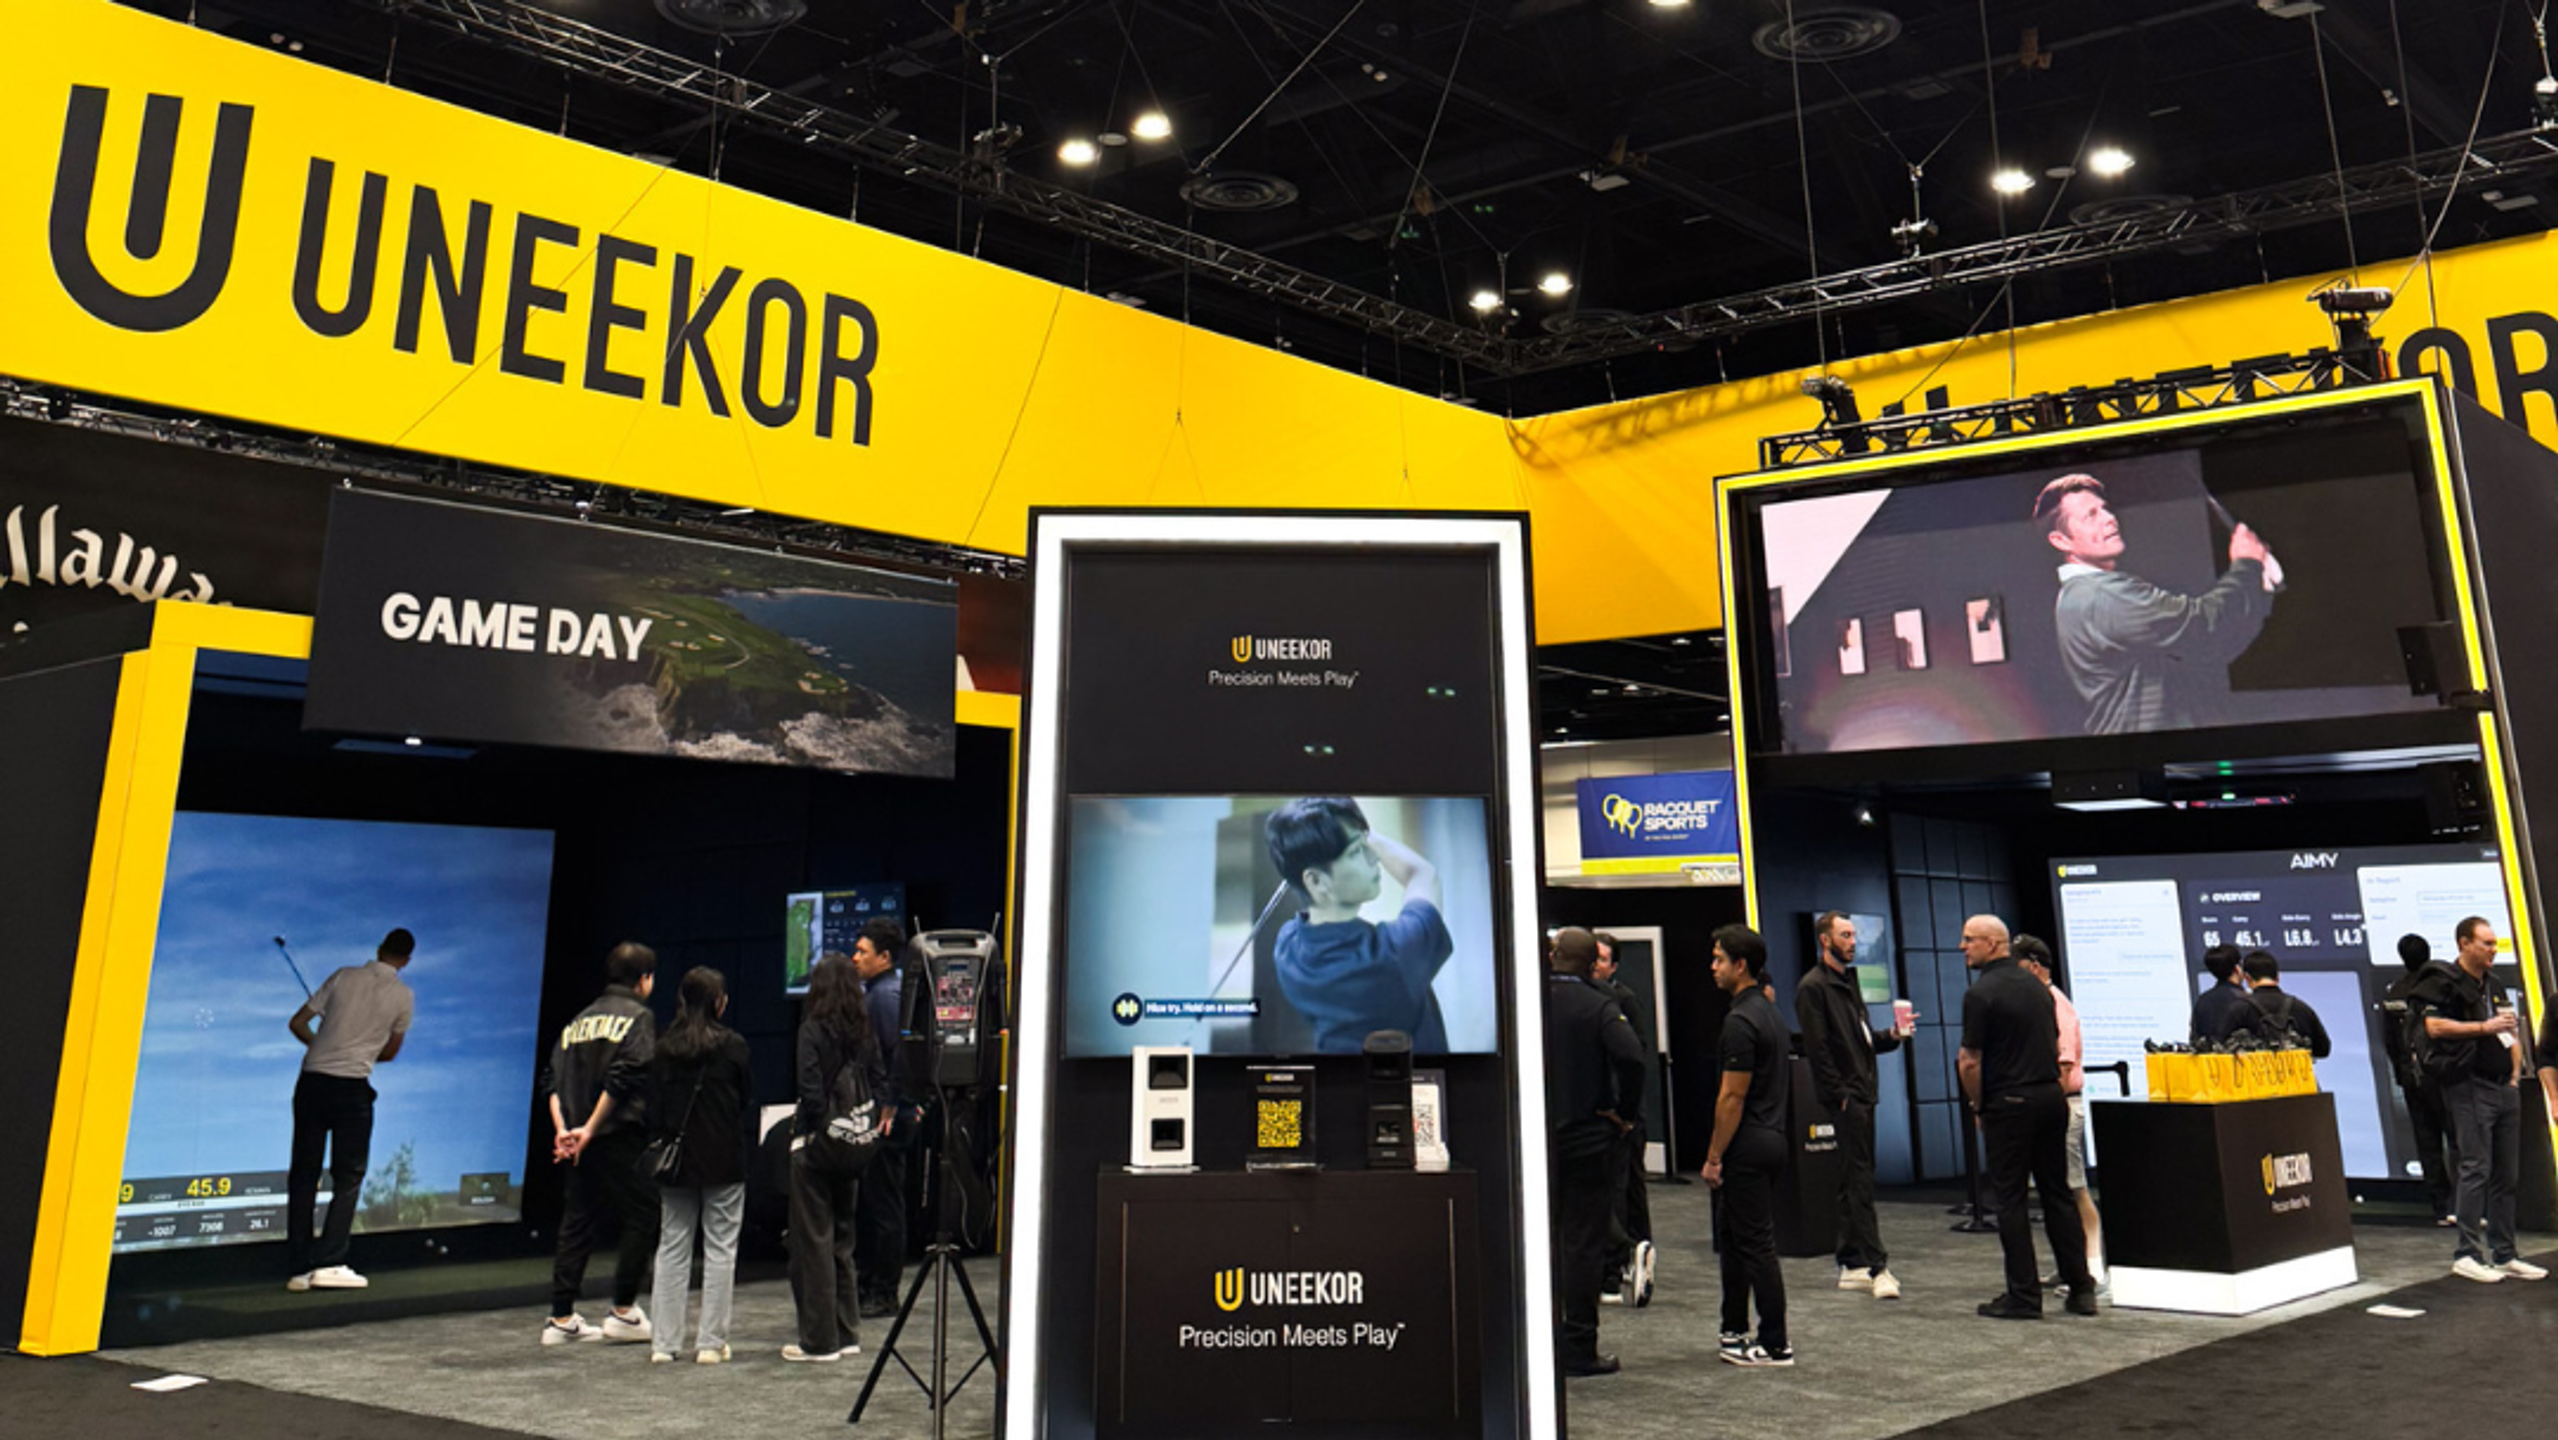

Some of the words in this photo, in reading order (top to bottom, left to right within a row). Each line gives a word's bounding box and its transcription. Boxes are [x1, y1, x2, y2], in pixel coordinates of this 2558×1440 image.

[291, 156, 880, 447] UNEEKOR
[381, 592, 539, 652] GAME
[547, 608, 652, 661] DAY
[1255, 638, 1332, 660] UNEEKOR
[1208, 670, 1274, 686] Precision
[1278, 671, 1321, 686] Meets
[1644, 800, 1722, 816] RACQUET
[1644, 815, 1708, 832] SPORTS
[2290, 853, 2339, 870] AIMY
[2212, 891, 2261, 902] OVERVIEW
[2203, 930, 2221, 947] 65
[2235, 930, 2262, 947] 45.1
[187, 1177, 231, 1197] 45.9
[1250, 1272, 1363, 1305] UNEEKOR
[1179, 1325, 1277, 1348] Precision
[1283, 1324, 1347, 1346] Meets
